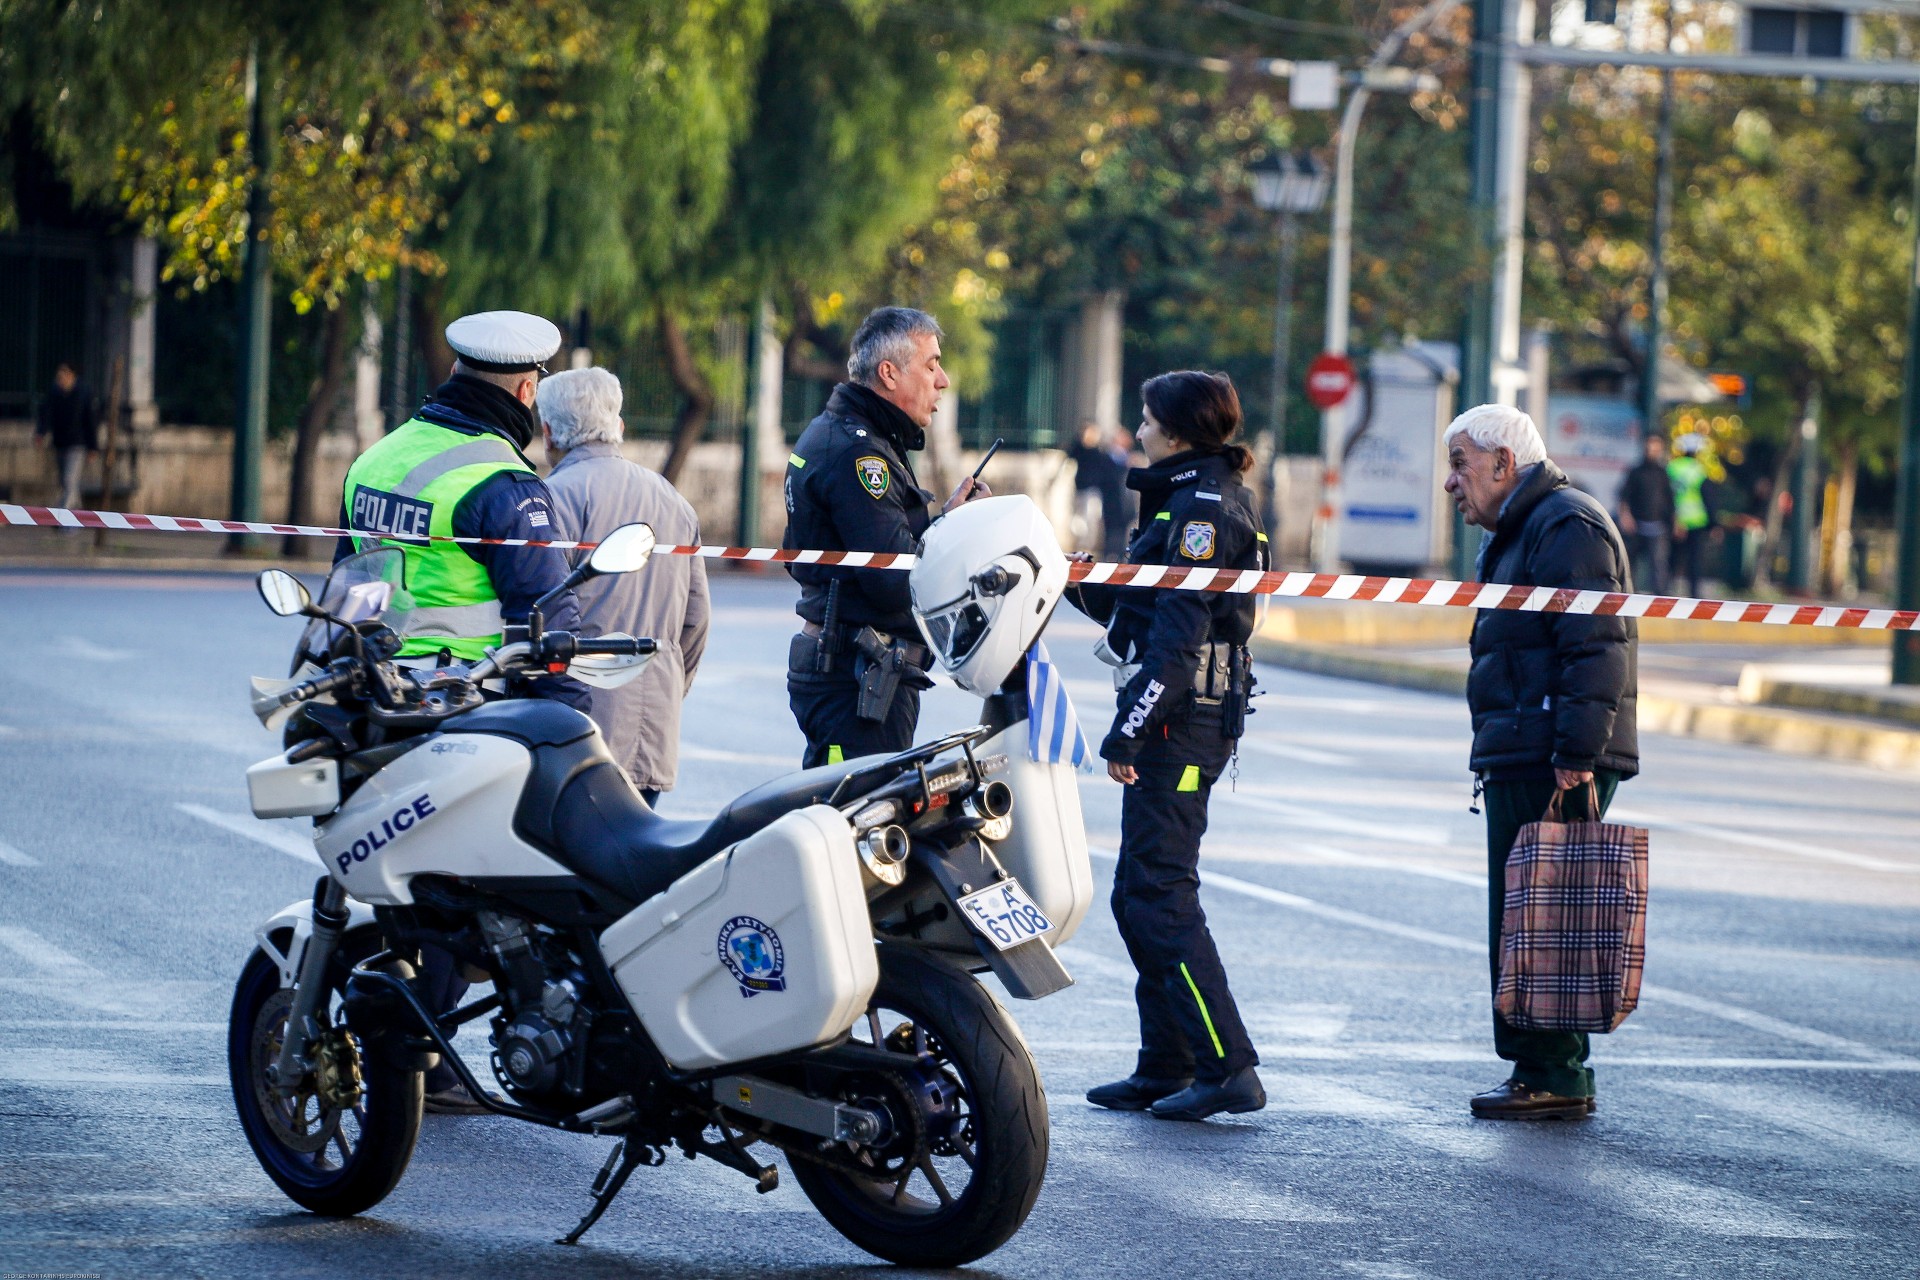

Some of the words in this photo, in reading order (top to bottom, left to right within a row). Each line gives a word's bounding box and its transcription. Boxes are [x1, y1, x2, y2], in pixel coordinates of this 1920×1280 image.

[1170, 469, 1198, 483] POLICE
[352, 491, 429, 536] POLICE
[1120, 678, 1166, 739] POLICE
[431, 739, 479, 756] aprilia
[336, 793, 437, 875] POLICE
[986, 904, 1049, 943] 6708
